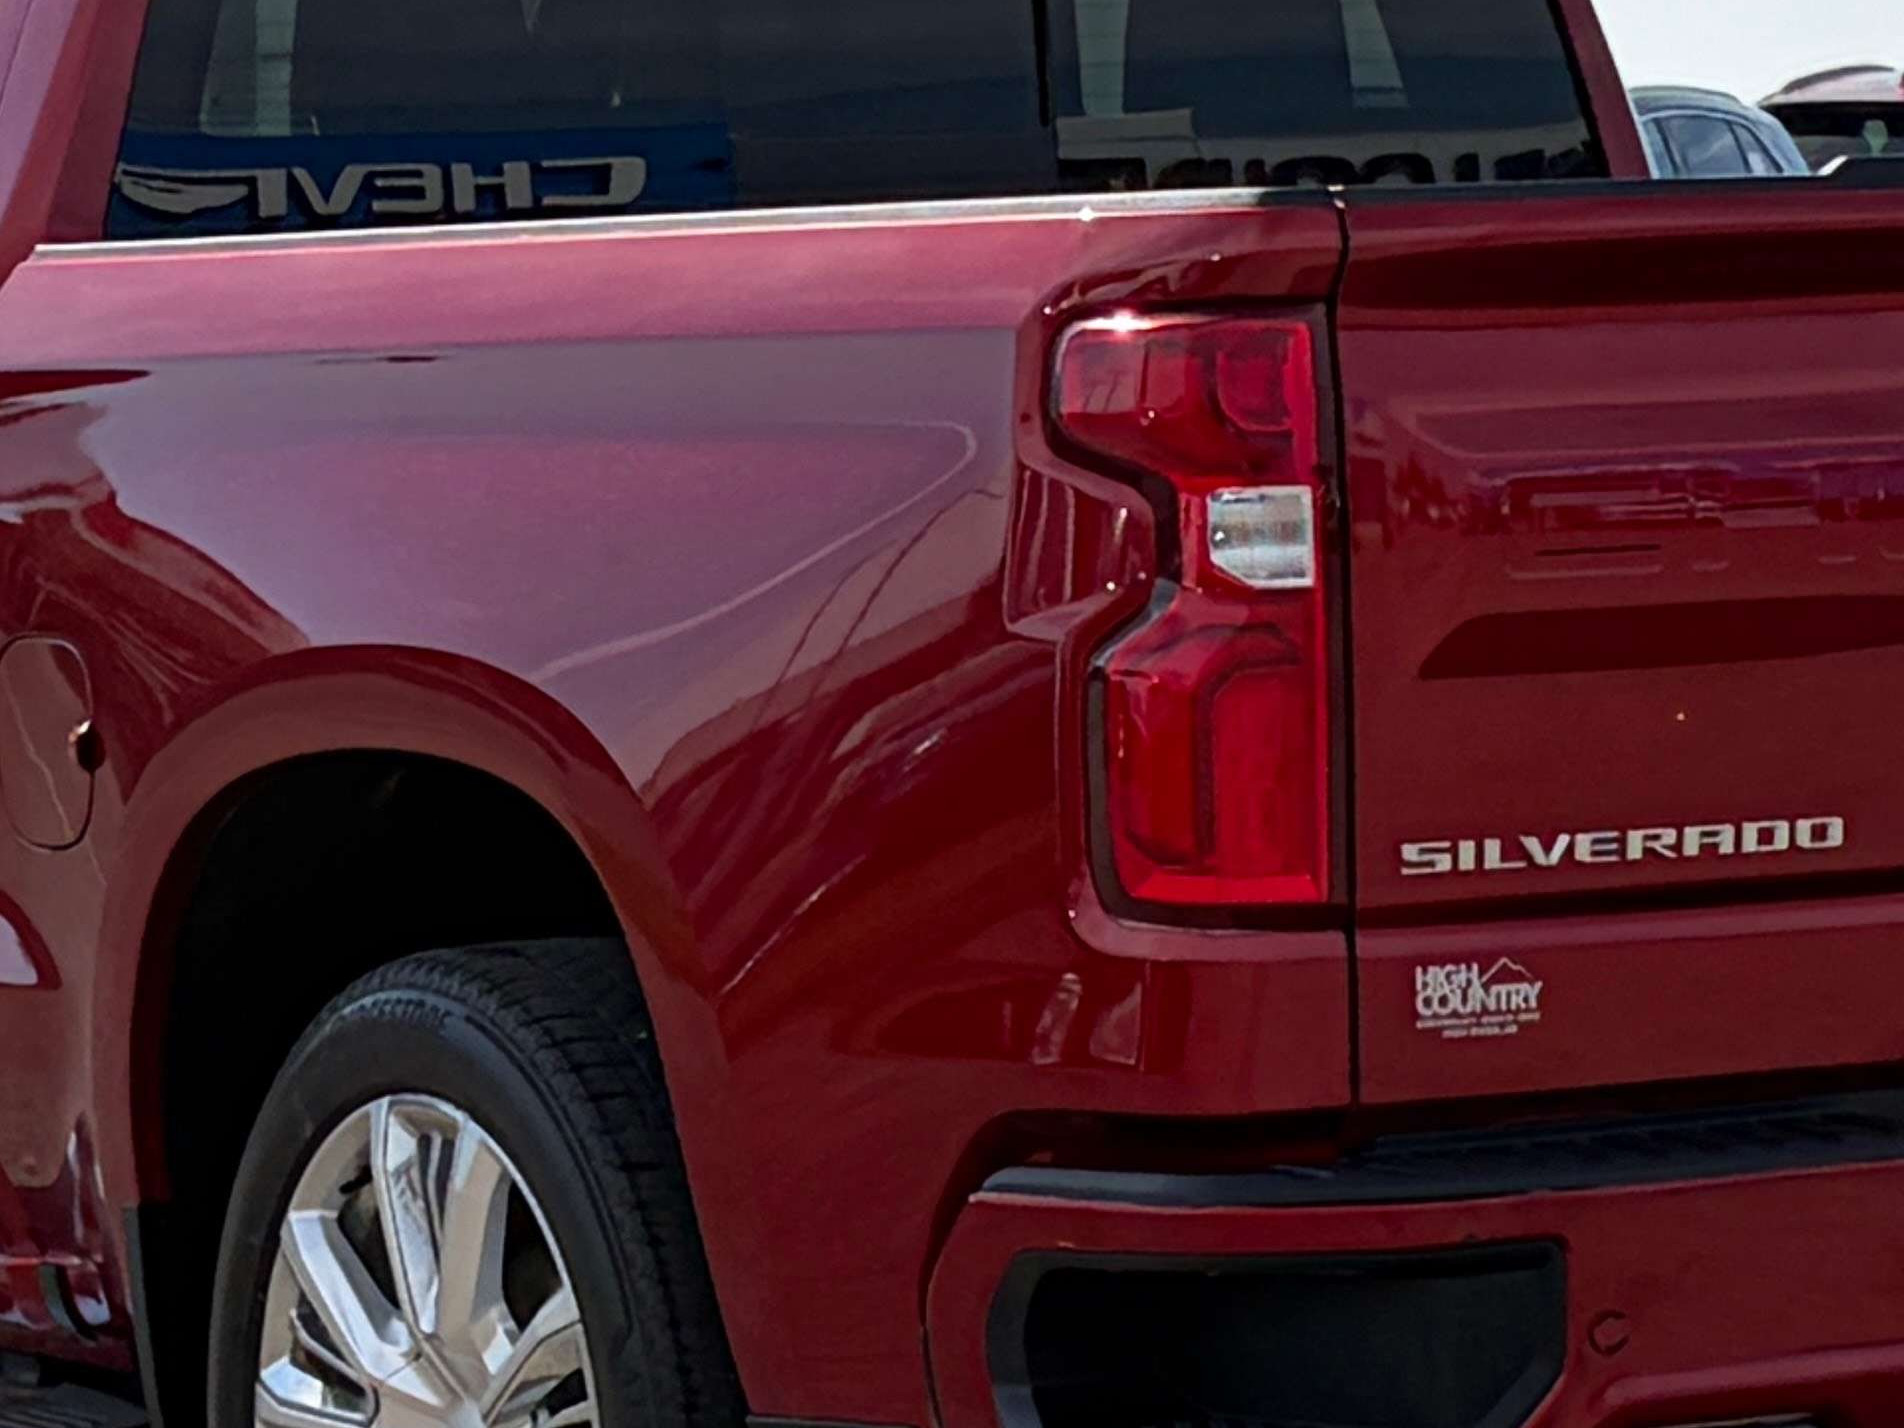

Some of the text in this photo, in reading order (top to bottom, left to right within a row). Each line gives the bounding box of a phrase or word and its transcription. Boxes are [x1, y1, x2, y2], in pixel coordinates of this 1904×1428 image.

[1400, 815, 1845, 875] SILVERADO
[1415, 962, 1480, 992] HIGH
[1415, 980, 1544, 1016] COUNTRY
